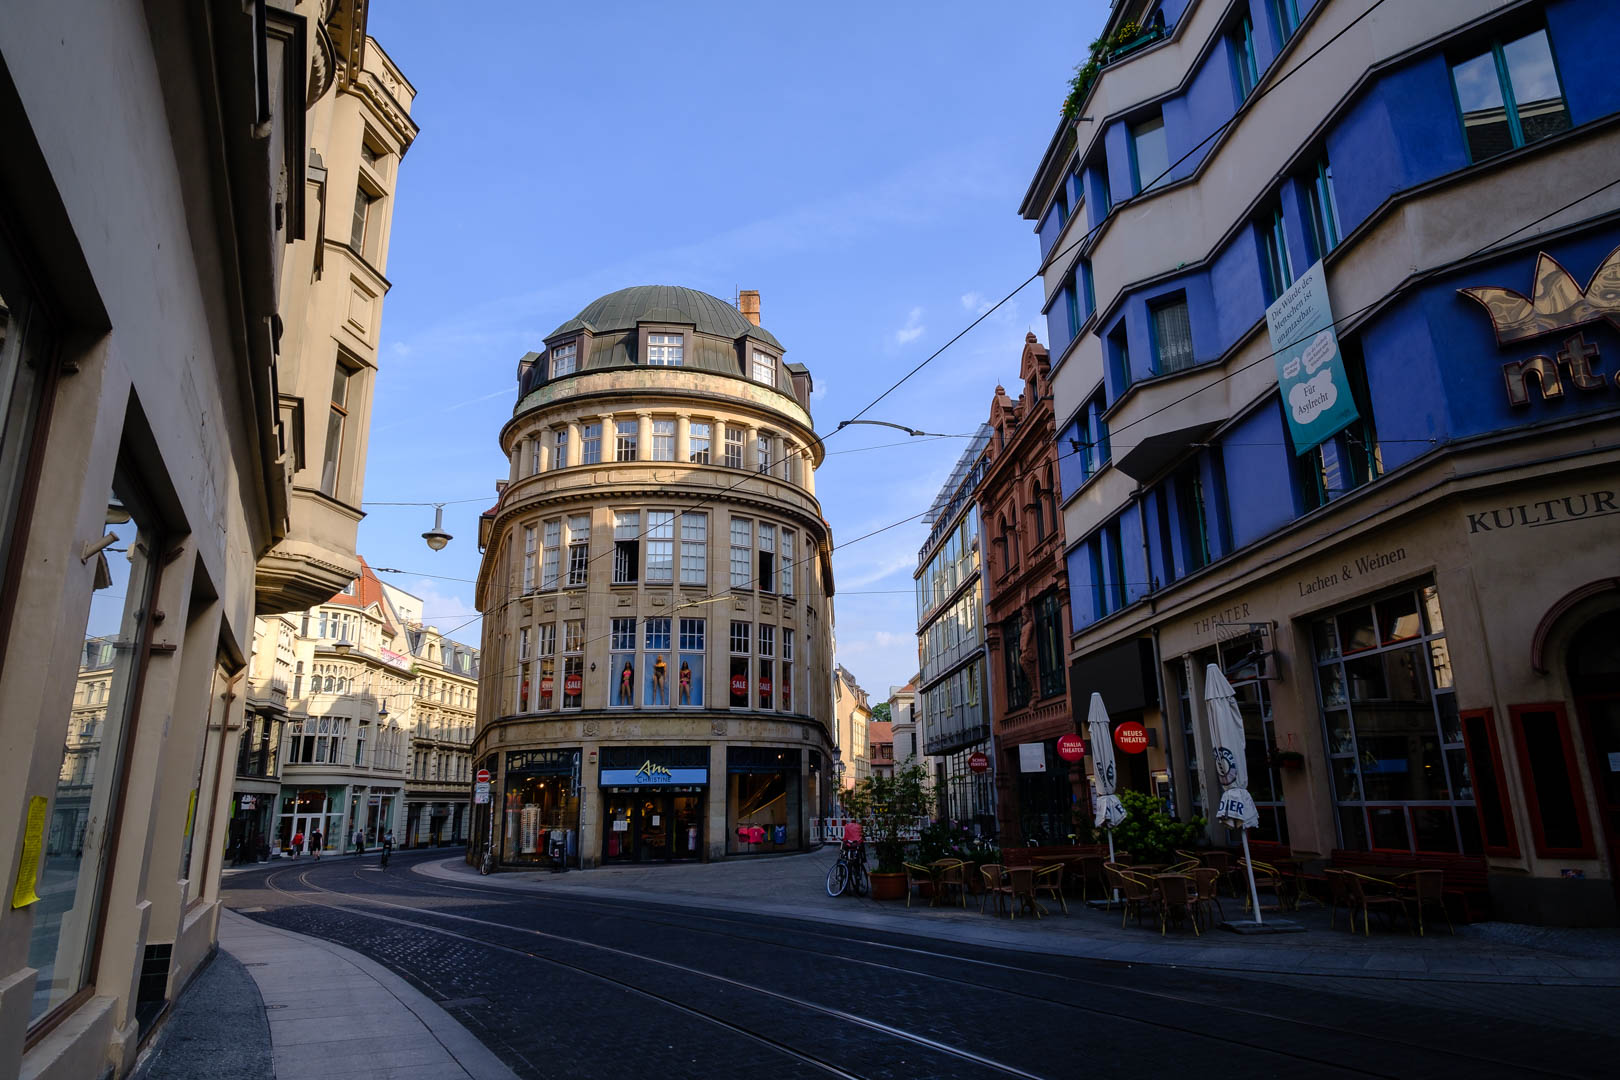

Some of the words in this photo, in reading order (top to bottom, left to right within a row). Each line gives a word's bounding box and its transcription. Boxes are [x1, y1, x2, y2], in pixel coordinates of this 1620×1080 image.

[1271, 306, 1282, 321] Die
[1282, 285, 1302, 309] Würde
[1302, 275, 1312, 291] des
[1274, 298, 1305, 333] Menschen
[1304, 290, 1312, 303] ist
[1298, 391, 1329, 415] Asylrecht
[1304, 385, 1316, 397] Für
[1298, 574, 1338, 597] Lachen
[1342, 565, 1352, 581] &
[1355, 548, 1406, 575] Weinen
[1194, 603, 1250, 635] THEATER
[568, 681, 581, 689] SALE
